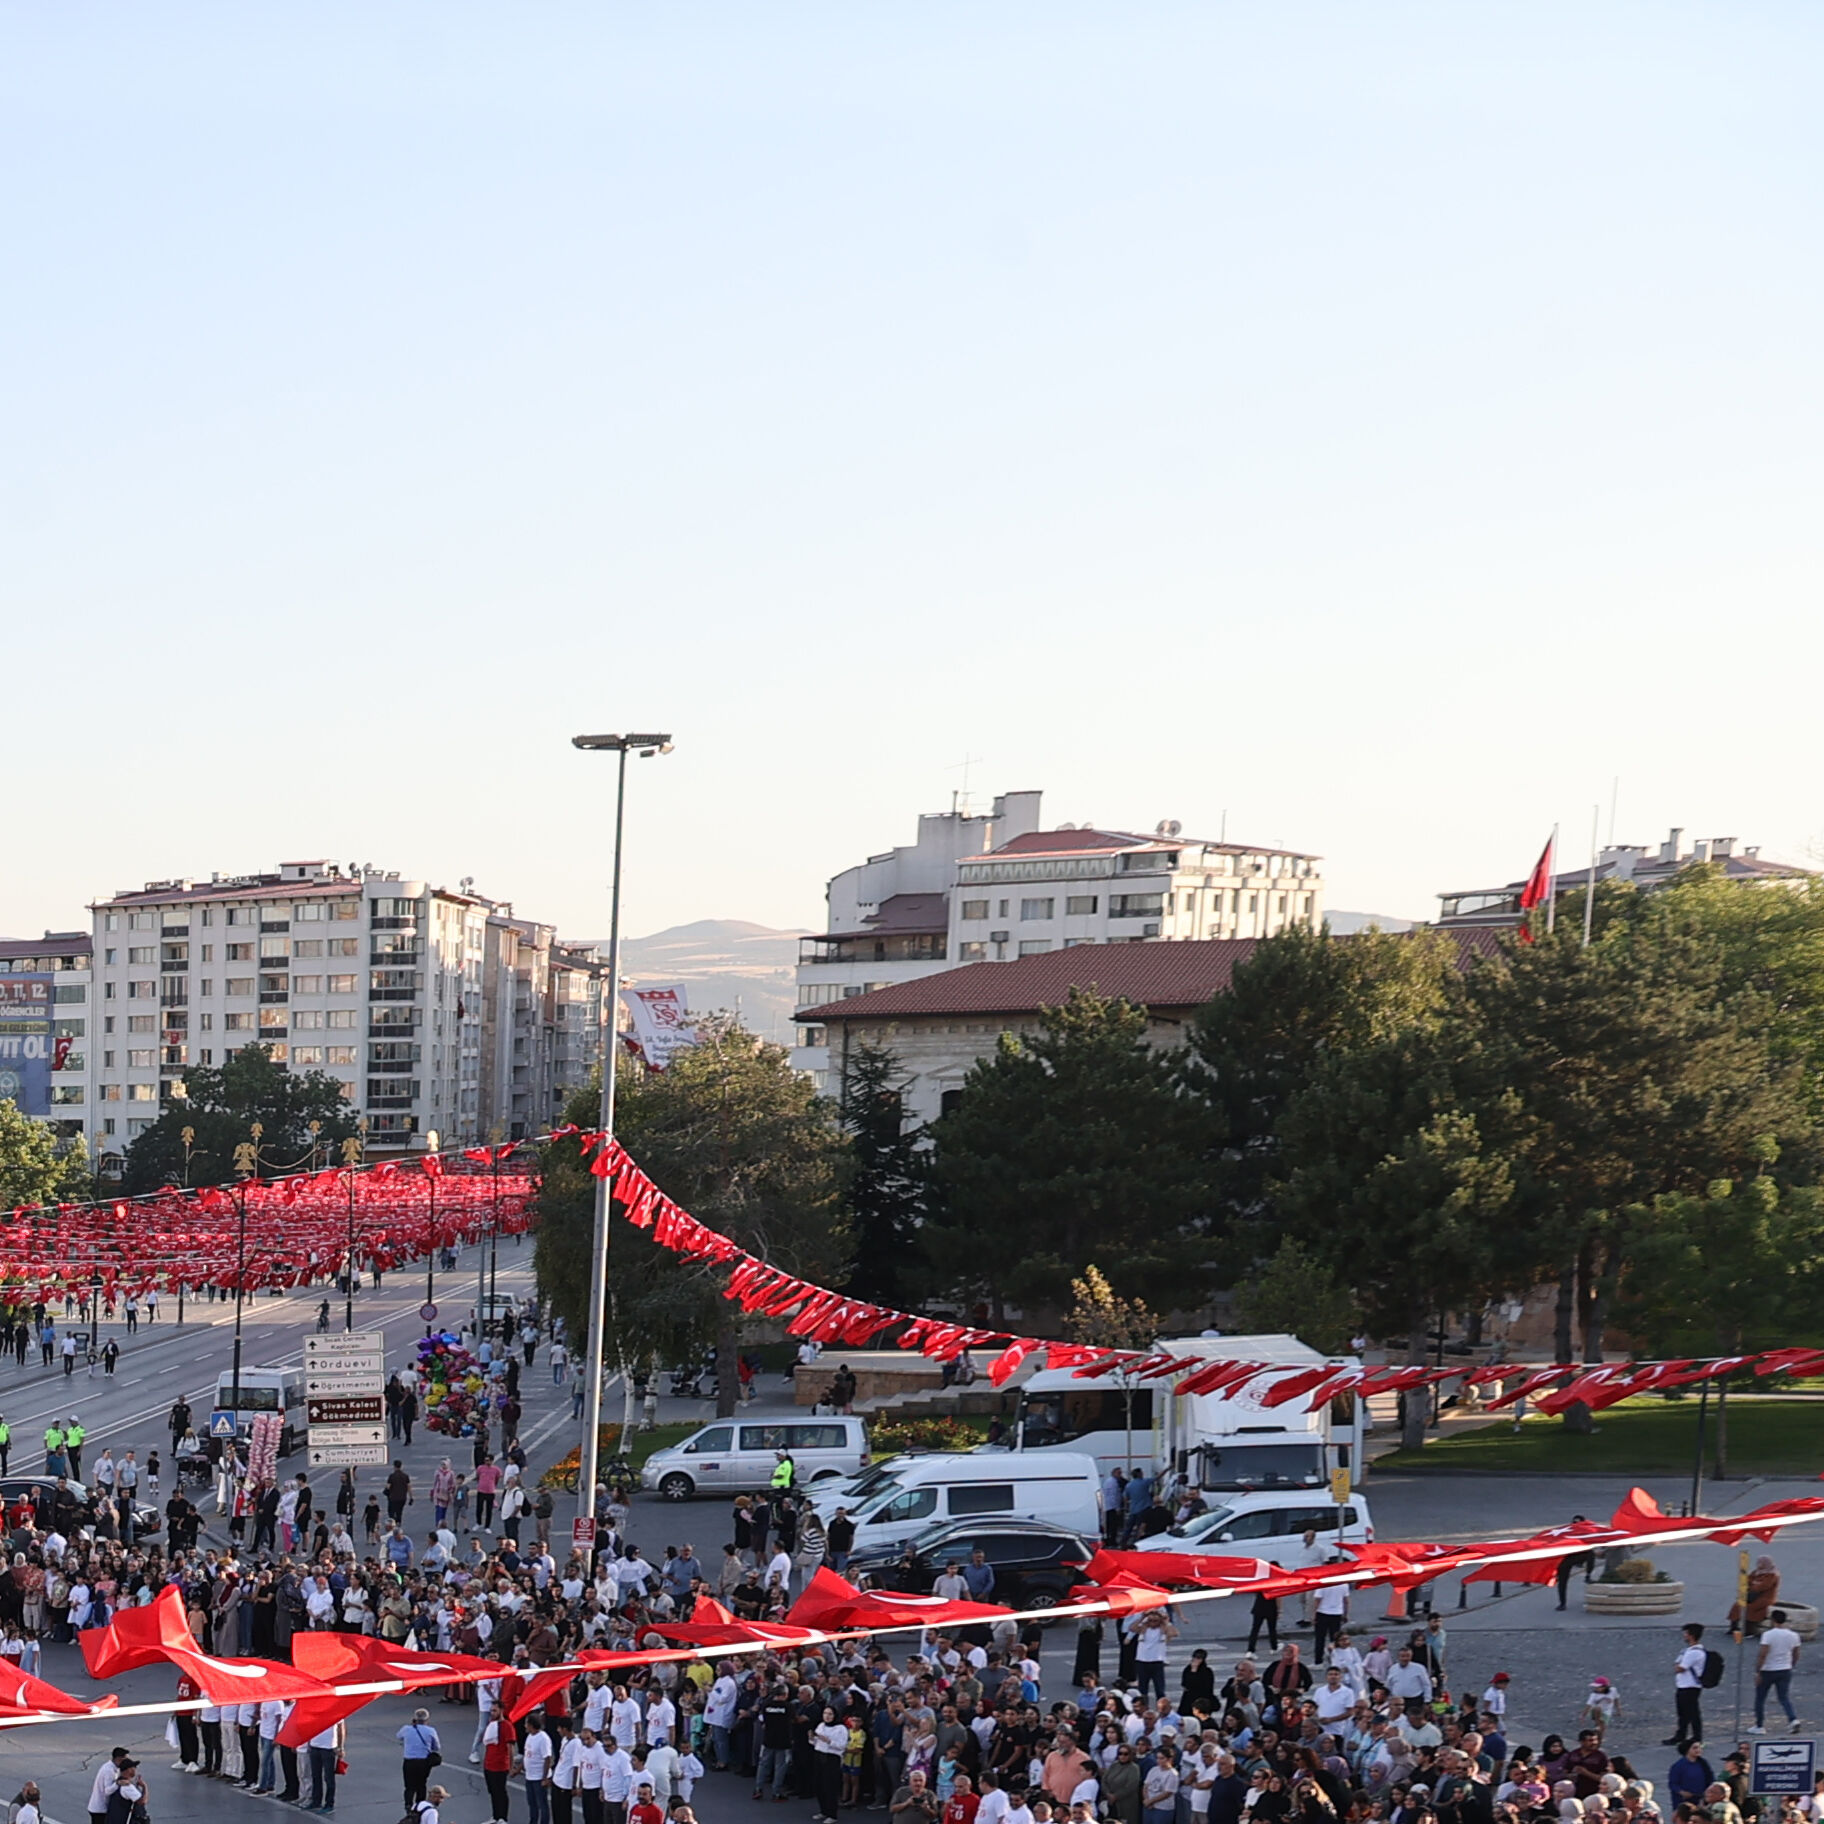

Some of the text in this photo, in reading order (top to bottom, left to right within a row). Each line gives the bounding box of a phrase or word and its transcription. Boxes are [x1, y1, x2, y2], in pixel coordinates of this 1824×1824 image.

[23, 1035, 49, 1059] OL
[320, 1360, 371, 1369] Orduevi
[321, 1381, 378, 1390] Öğretmenevi
[322, 1401, 378, 1410] Sivas Kalesi
[322, 1412, 380, 1420] Gökmedrese
